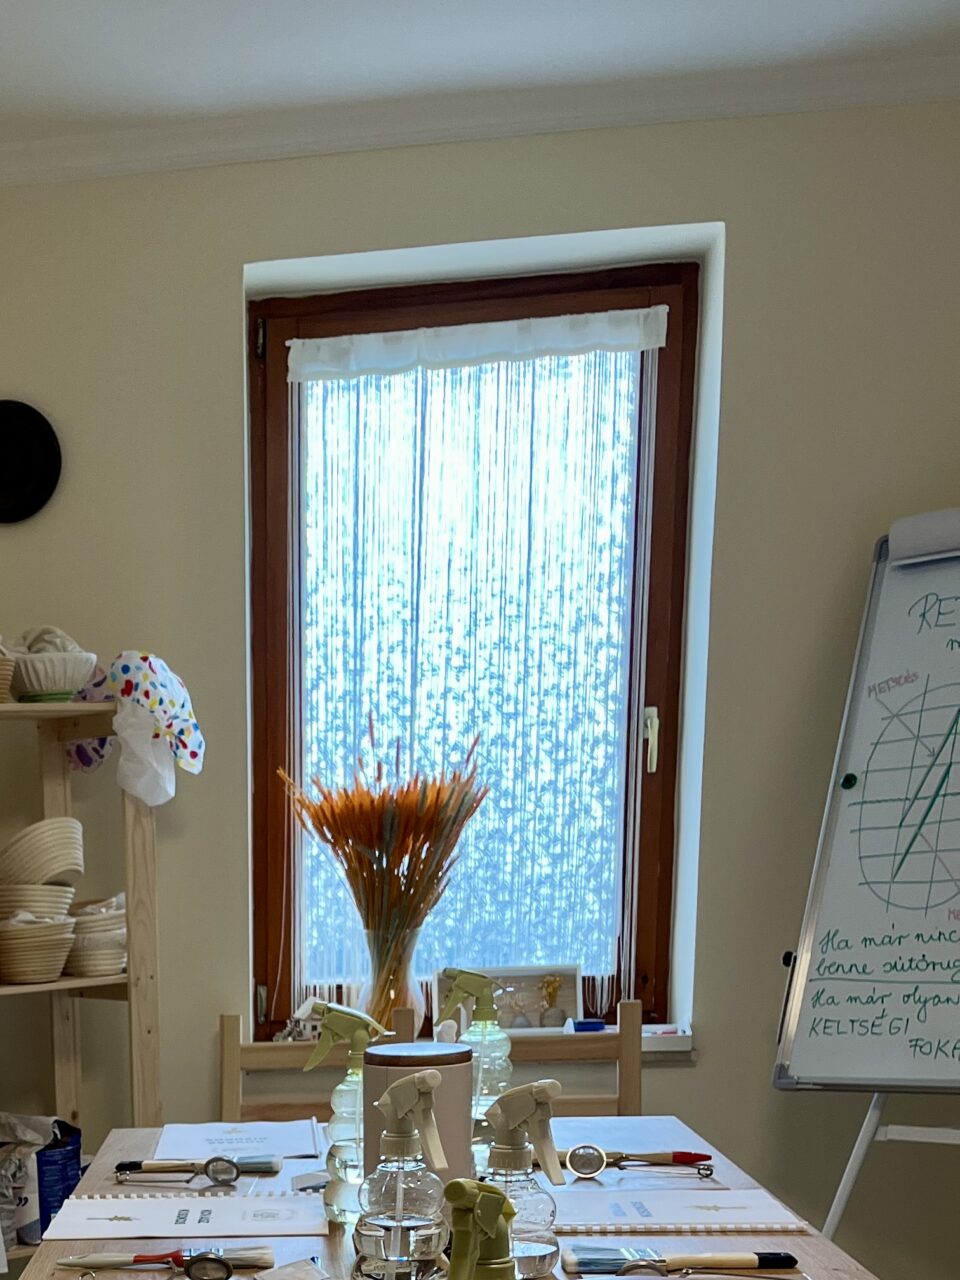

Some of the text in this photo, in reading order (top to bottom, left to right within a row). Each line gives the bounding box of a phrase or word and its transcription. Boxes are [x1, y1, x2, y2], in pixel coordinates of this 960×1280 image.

[818, 929, 853, 954] Ha
[861, 923, 910, 948] már
[815, 957, 874, 977] benne
[809, 988, 840, 1009] Ha
[846, 987, 893, 1005] már
